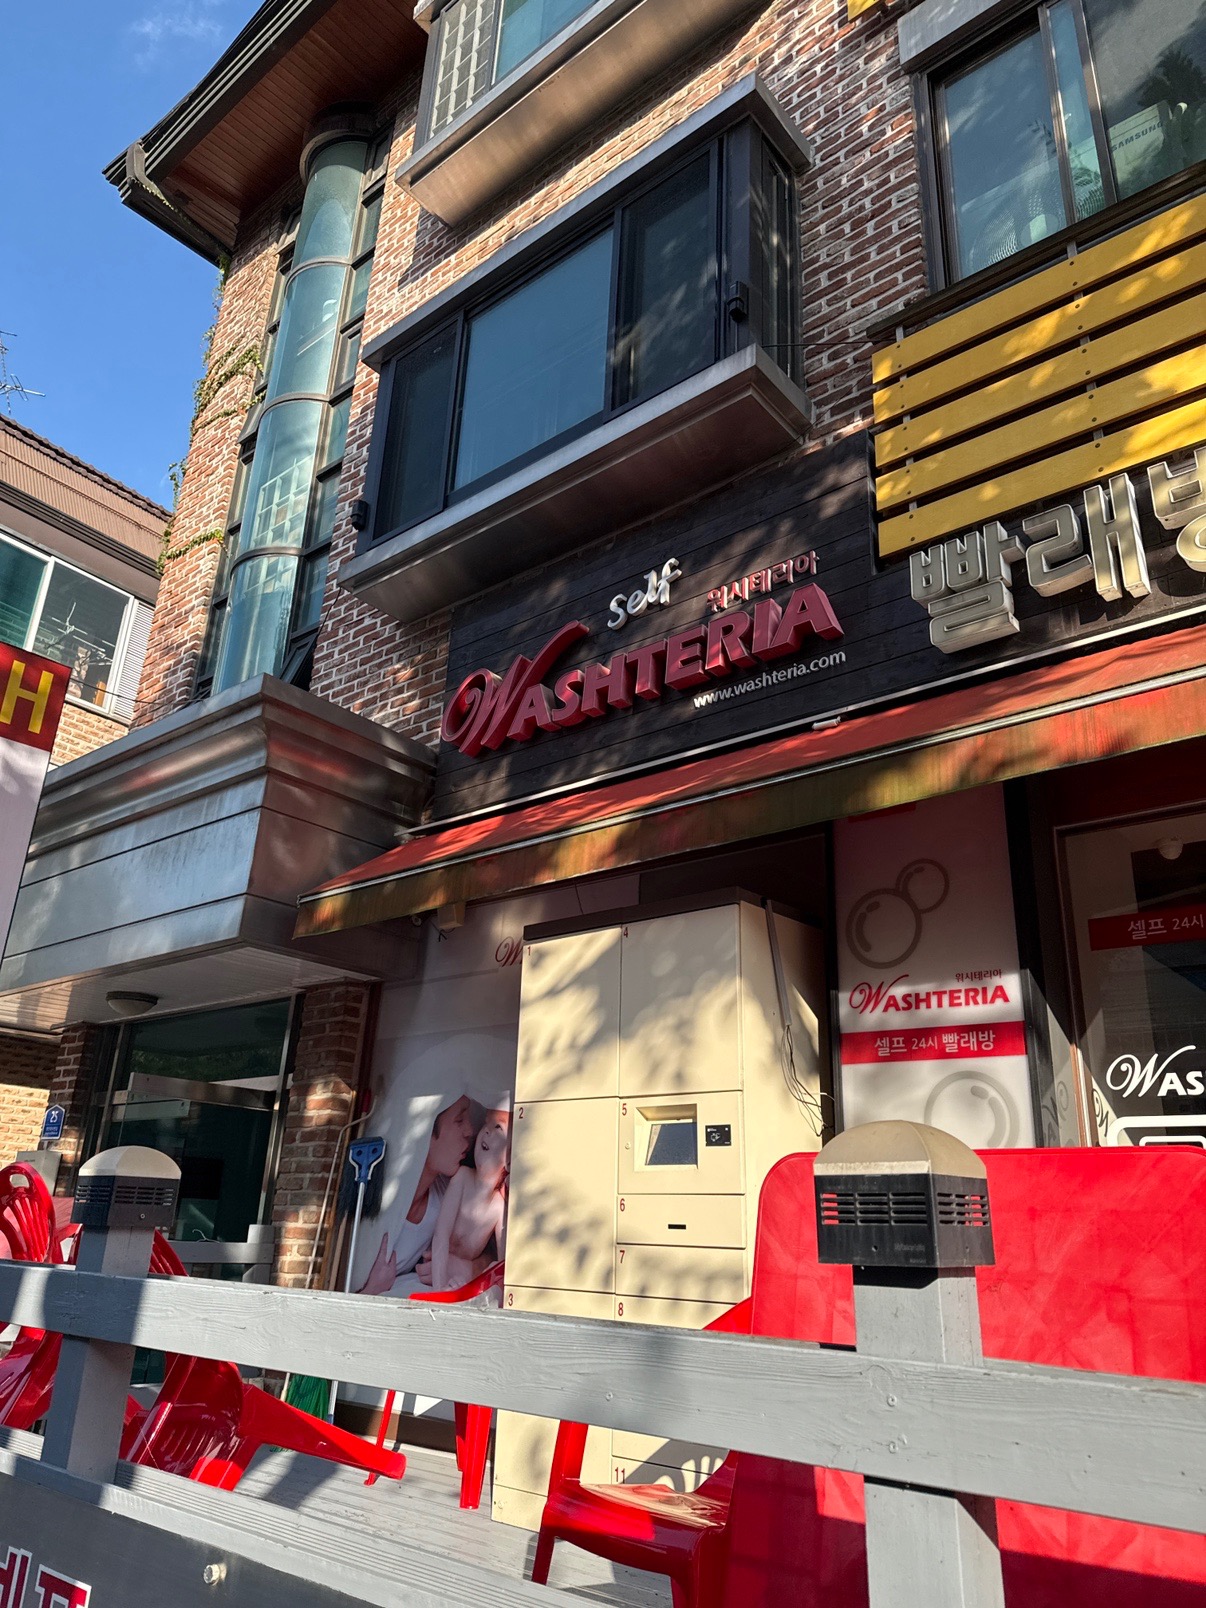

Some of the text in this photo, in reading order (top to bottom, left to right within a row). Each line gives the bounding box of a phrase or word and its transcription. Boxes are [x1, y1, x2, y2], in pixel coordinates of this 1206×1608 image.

[441, 582, 844, 758] WASHTERIA
[694, 649, 847, 708] www.washteria.com
[623, 927, 629, 938] 4
[1128, 914, 1204, 940] 셀프 24시
[495, 936, 523, 967] W
[849, 974, 1010, 1014] WASHTERIA
[874, 1030, 996, 1057] 셀프 24시 빨래방
[1106, 1045, 1206, 1098] WAS
[518, 1106, 524, 1120] 2
[622, 1102, 628, 1116] 5
[619, 1198, 625, 1212] 6
[619, 1250, 625, 1264] 7
[508, 1293, 514, 1307] 3
[617, 1302, 624, 1317] 8
[615, 1467, 625, 1484] 11
